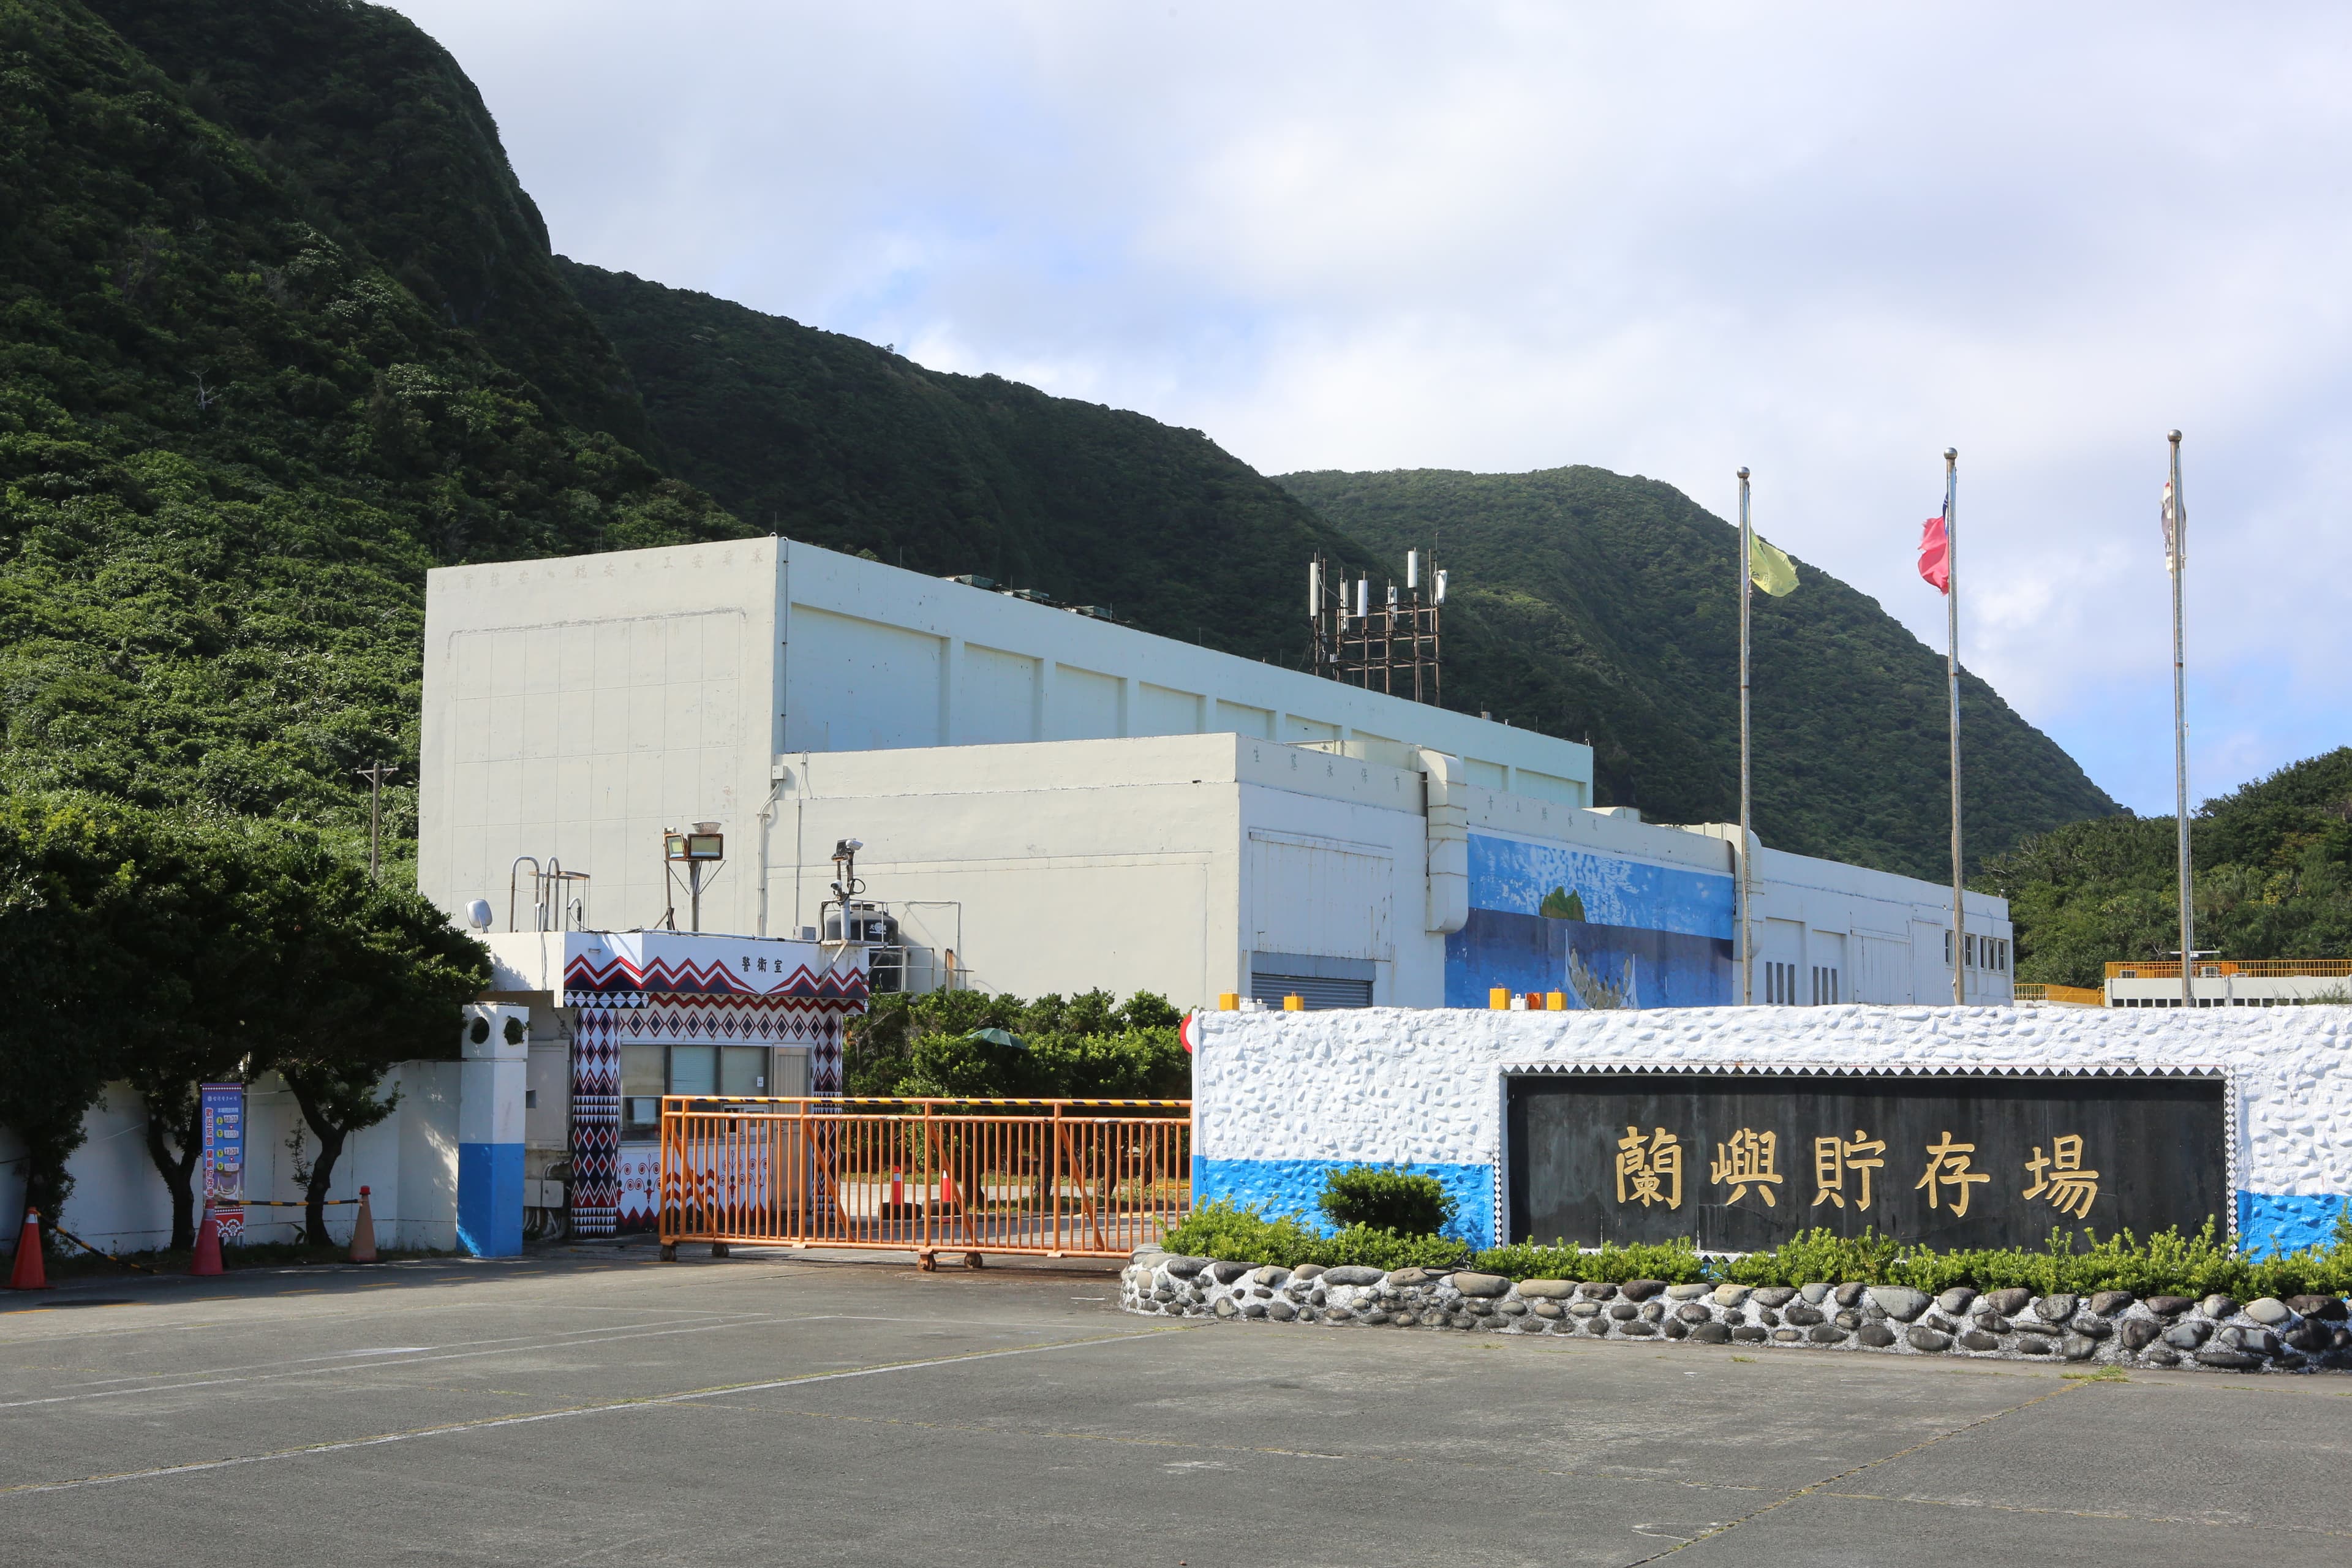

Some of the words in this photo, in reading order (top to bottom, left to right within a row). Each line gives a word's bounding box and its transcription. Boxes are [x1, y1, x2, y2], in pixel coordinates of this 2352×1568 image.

[742, 956, 783, 973] 警衛室
[1615, 1126, 2099, 1219] 蘭嶼貯存場
